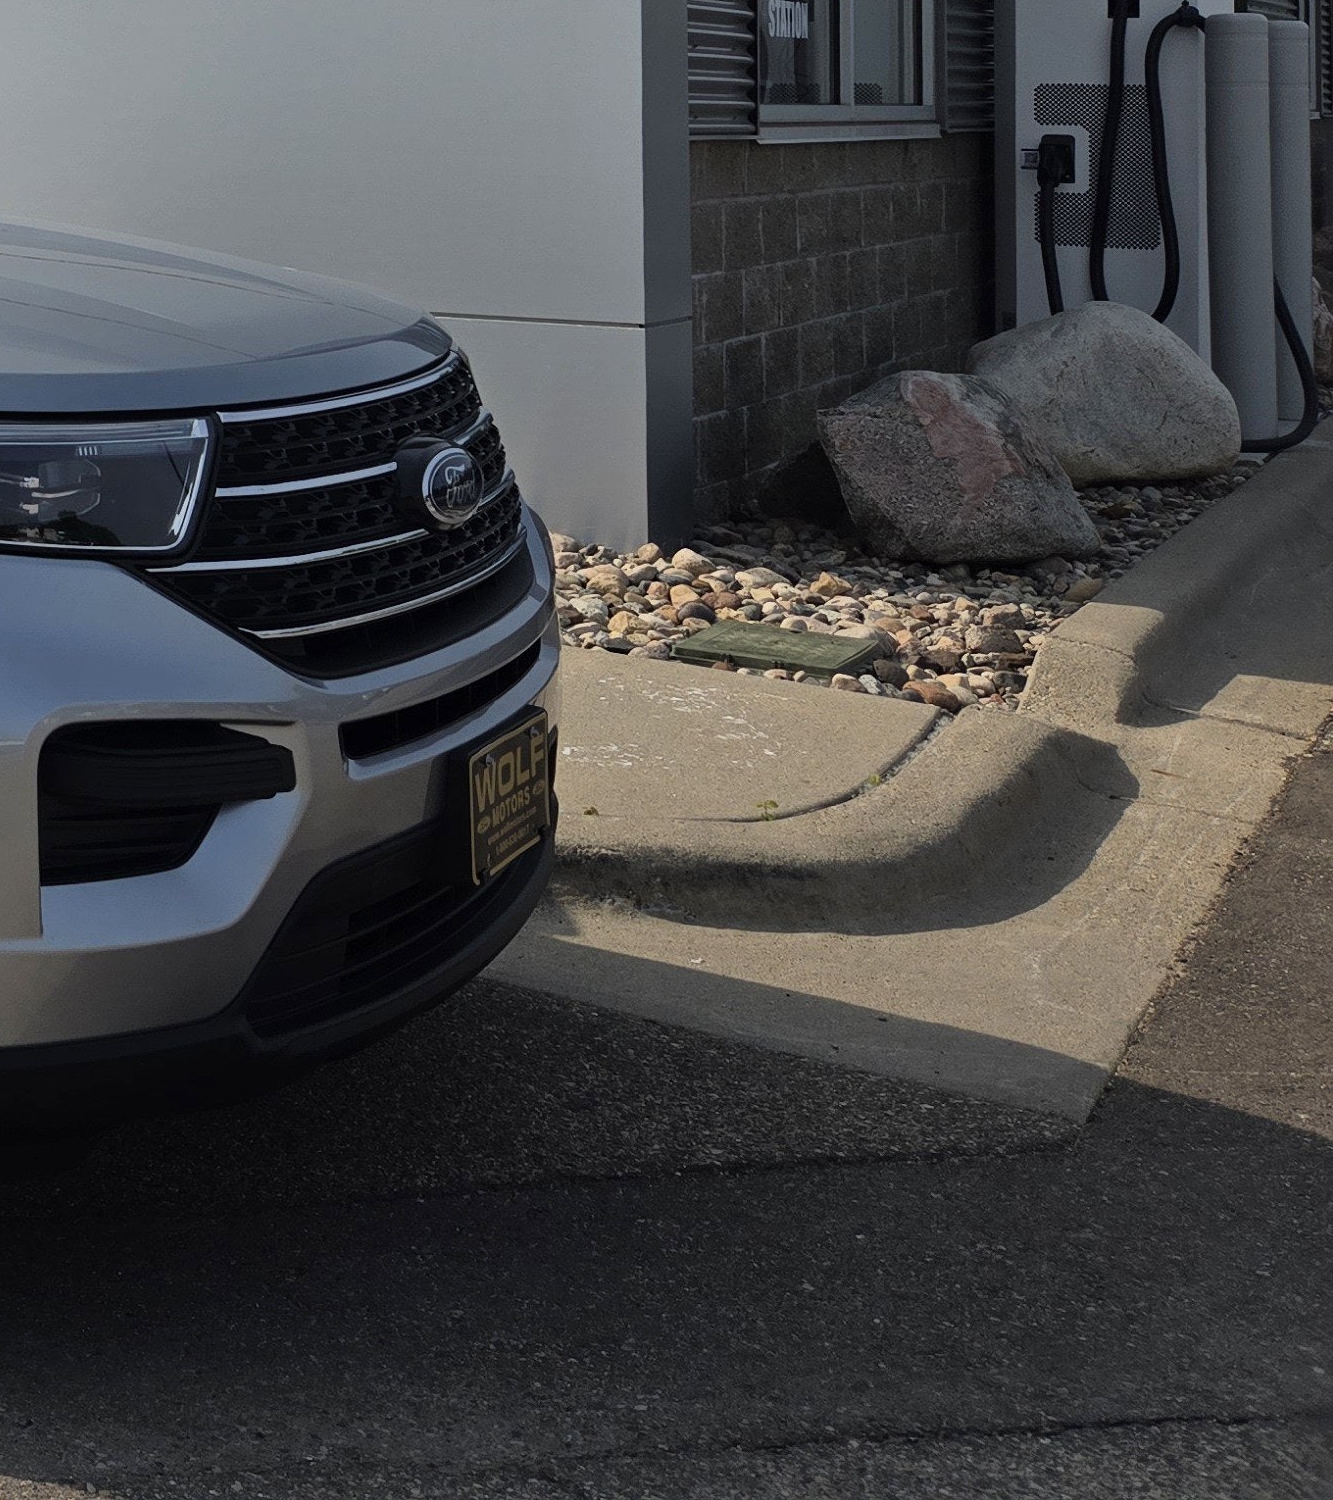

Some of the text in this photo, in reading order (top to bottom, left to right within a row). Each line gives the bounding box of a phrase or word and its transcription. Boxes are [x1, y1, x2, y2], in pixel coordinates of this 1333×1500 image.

[444, 463, 476, 508] Ford
[474, 732, 544, 812] WOLF
[492, 786, 530, 828] MOTORS
